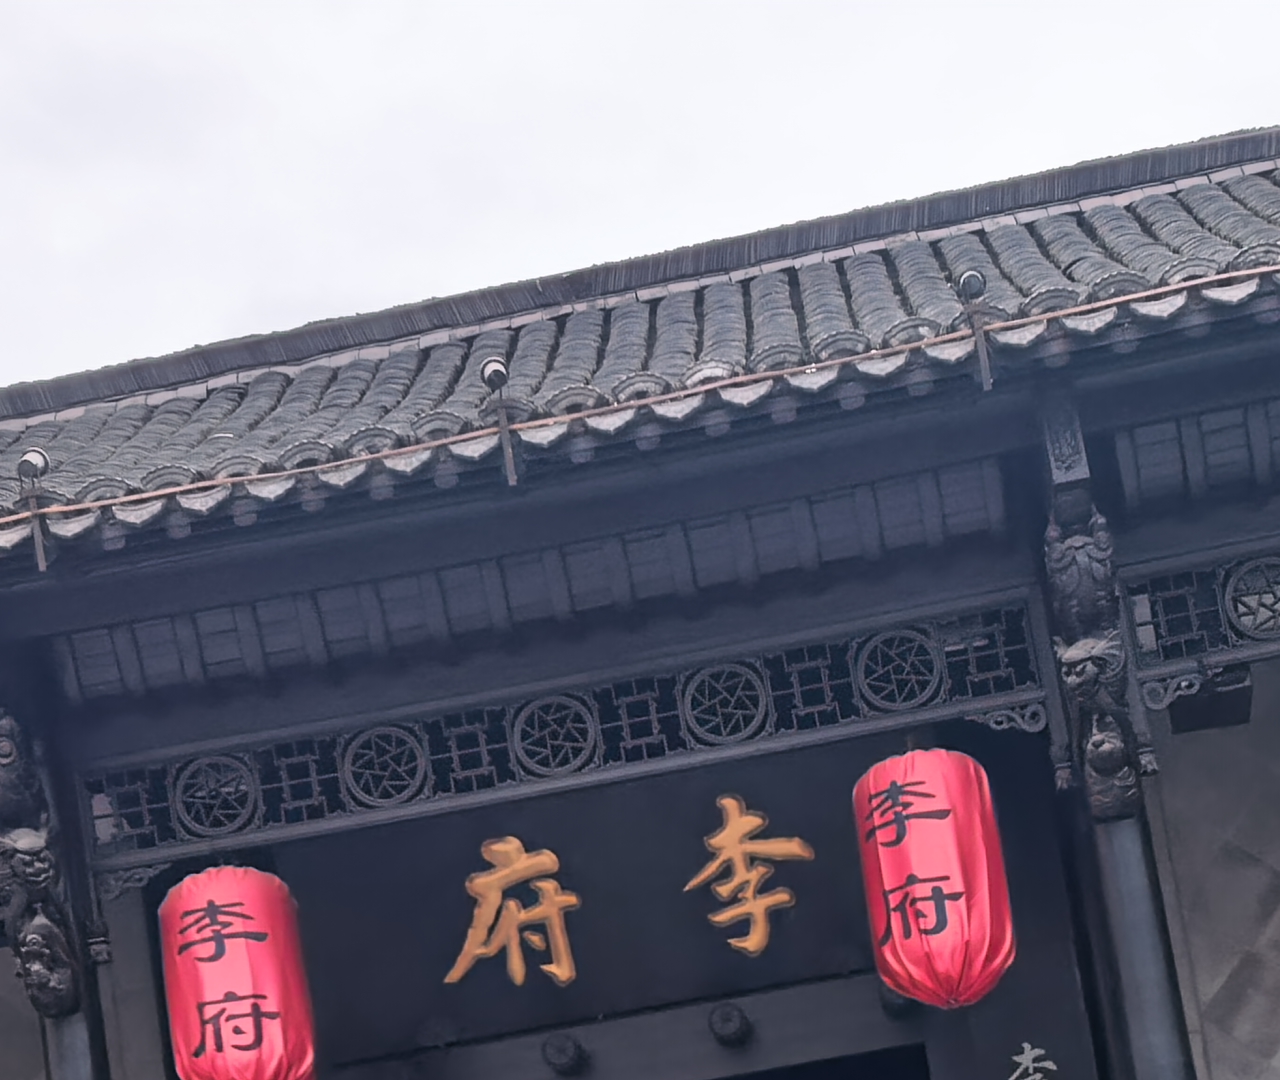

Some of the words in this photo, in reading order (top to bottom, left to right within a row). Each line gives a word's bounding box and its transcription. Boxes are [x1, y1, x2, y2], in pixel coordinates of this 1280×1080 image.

[442, 795, 817, 987] 李府
[861, 779, 967, 948] 李府
[176, 899, 283, 1060] 李府
